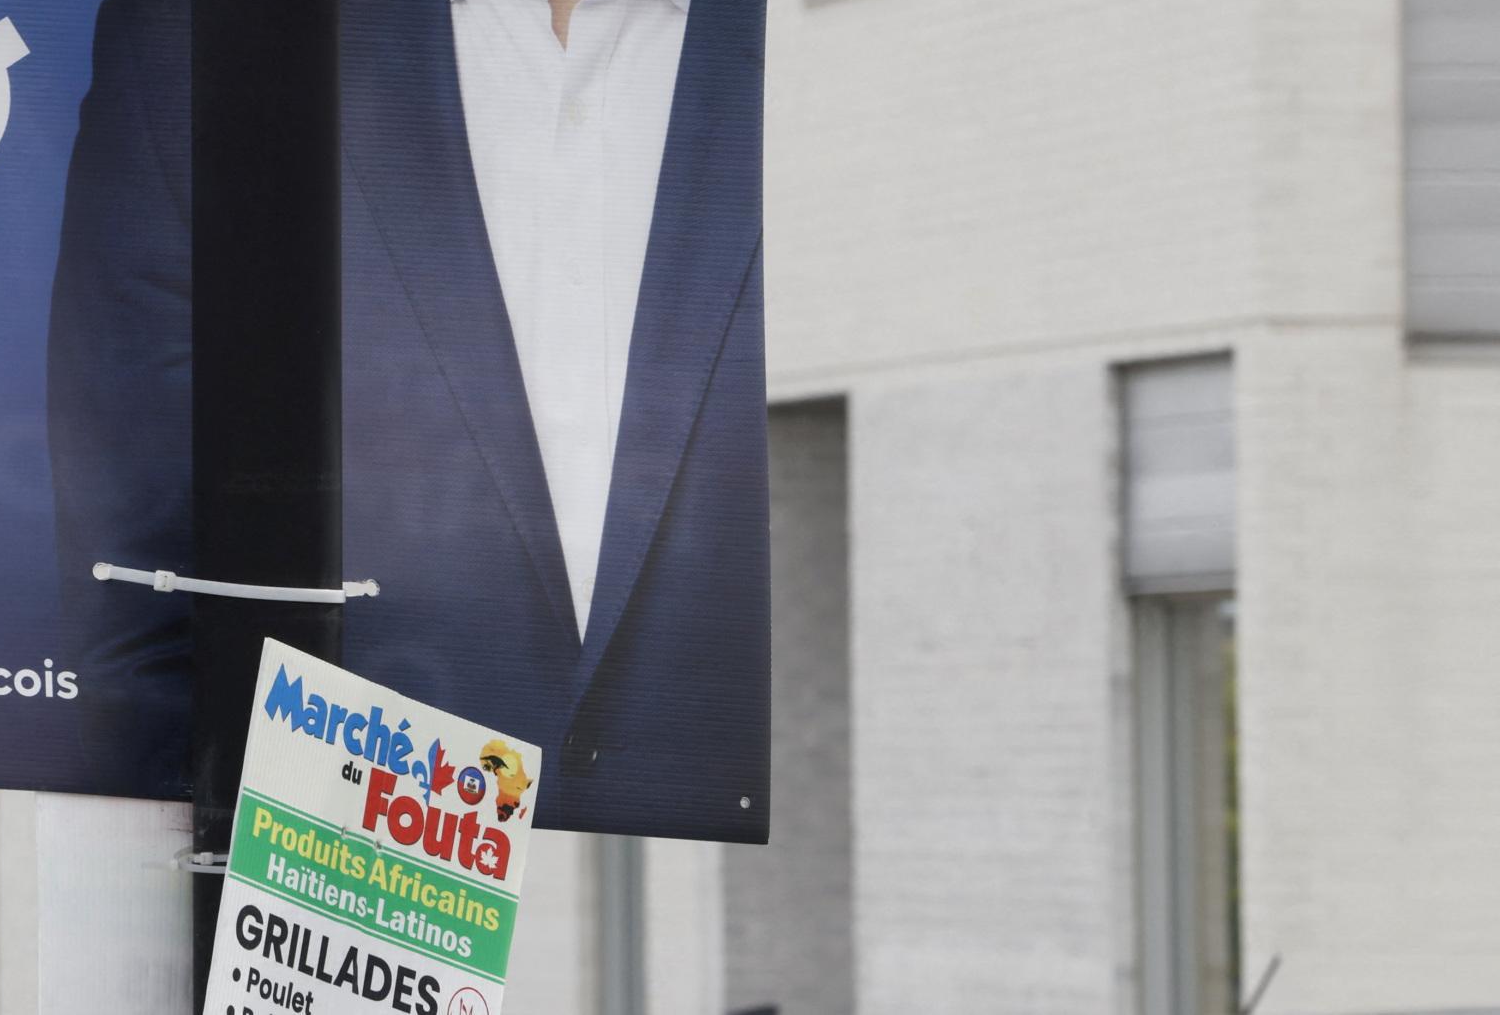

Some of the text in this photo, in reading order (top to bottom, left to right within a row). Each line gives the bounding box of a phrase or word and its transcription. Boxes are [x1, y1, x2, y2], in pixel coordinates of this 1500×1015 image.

[264, 663, 414, 775] Marché
[341, 761, 363, 786] du
[252, 807, 500, 932] Produits Africains
[362, 767, 512, 881] Fouta
[235, 904, 441, 1015] GRILLADES
[246, 967, 314, 1015] Poulet
